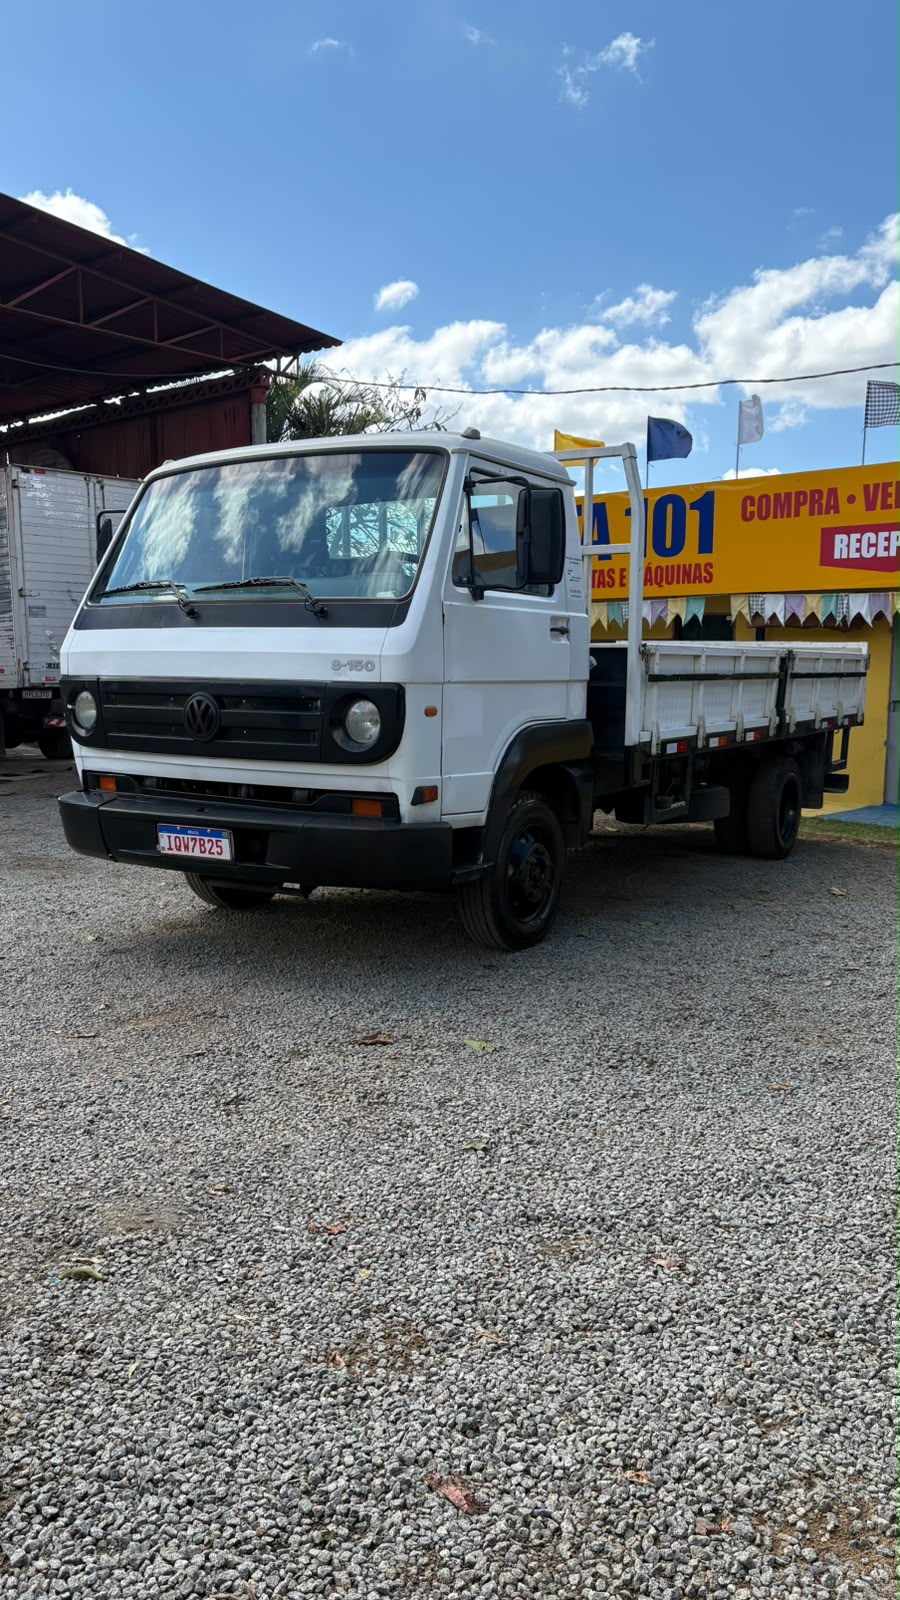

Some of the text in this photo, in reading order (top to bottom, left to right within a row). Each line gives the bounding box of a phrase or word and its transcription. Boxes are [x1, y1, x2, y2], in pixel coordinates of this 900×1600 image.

[741, 487, 840, 522] COMPRA
[834, 531, 900, 559] RECEP
[619, 568, 627, 587] E
[643, 562, 714, 587] ÁQUINAS
[331, 659, 376, 672] 8-150
[186, 694, 217, 738] VW
[167, 835, 224, 856] IQW7B25
